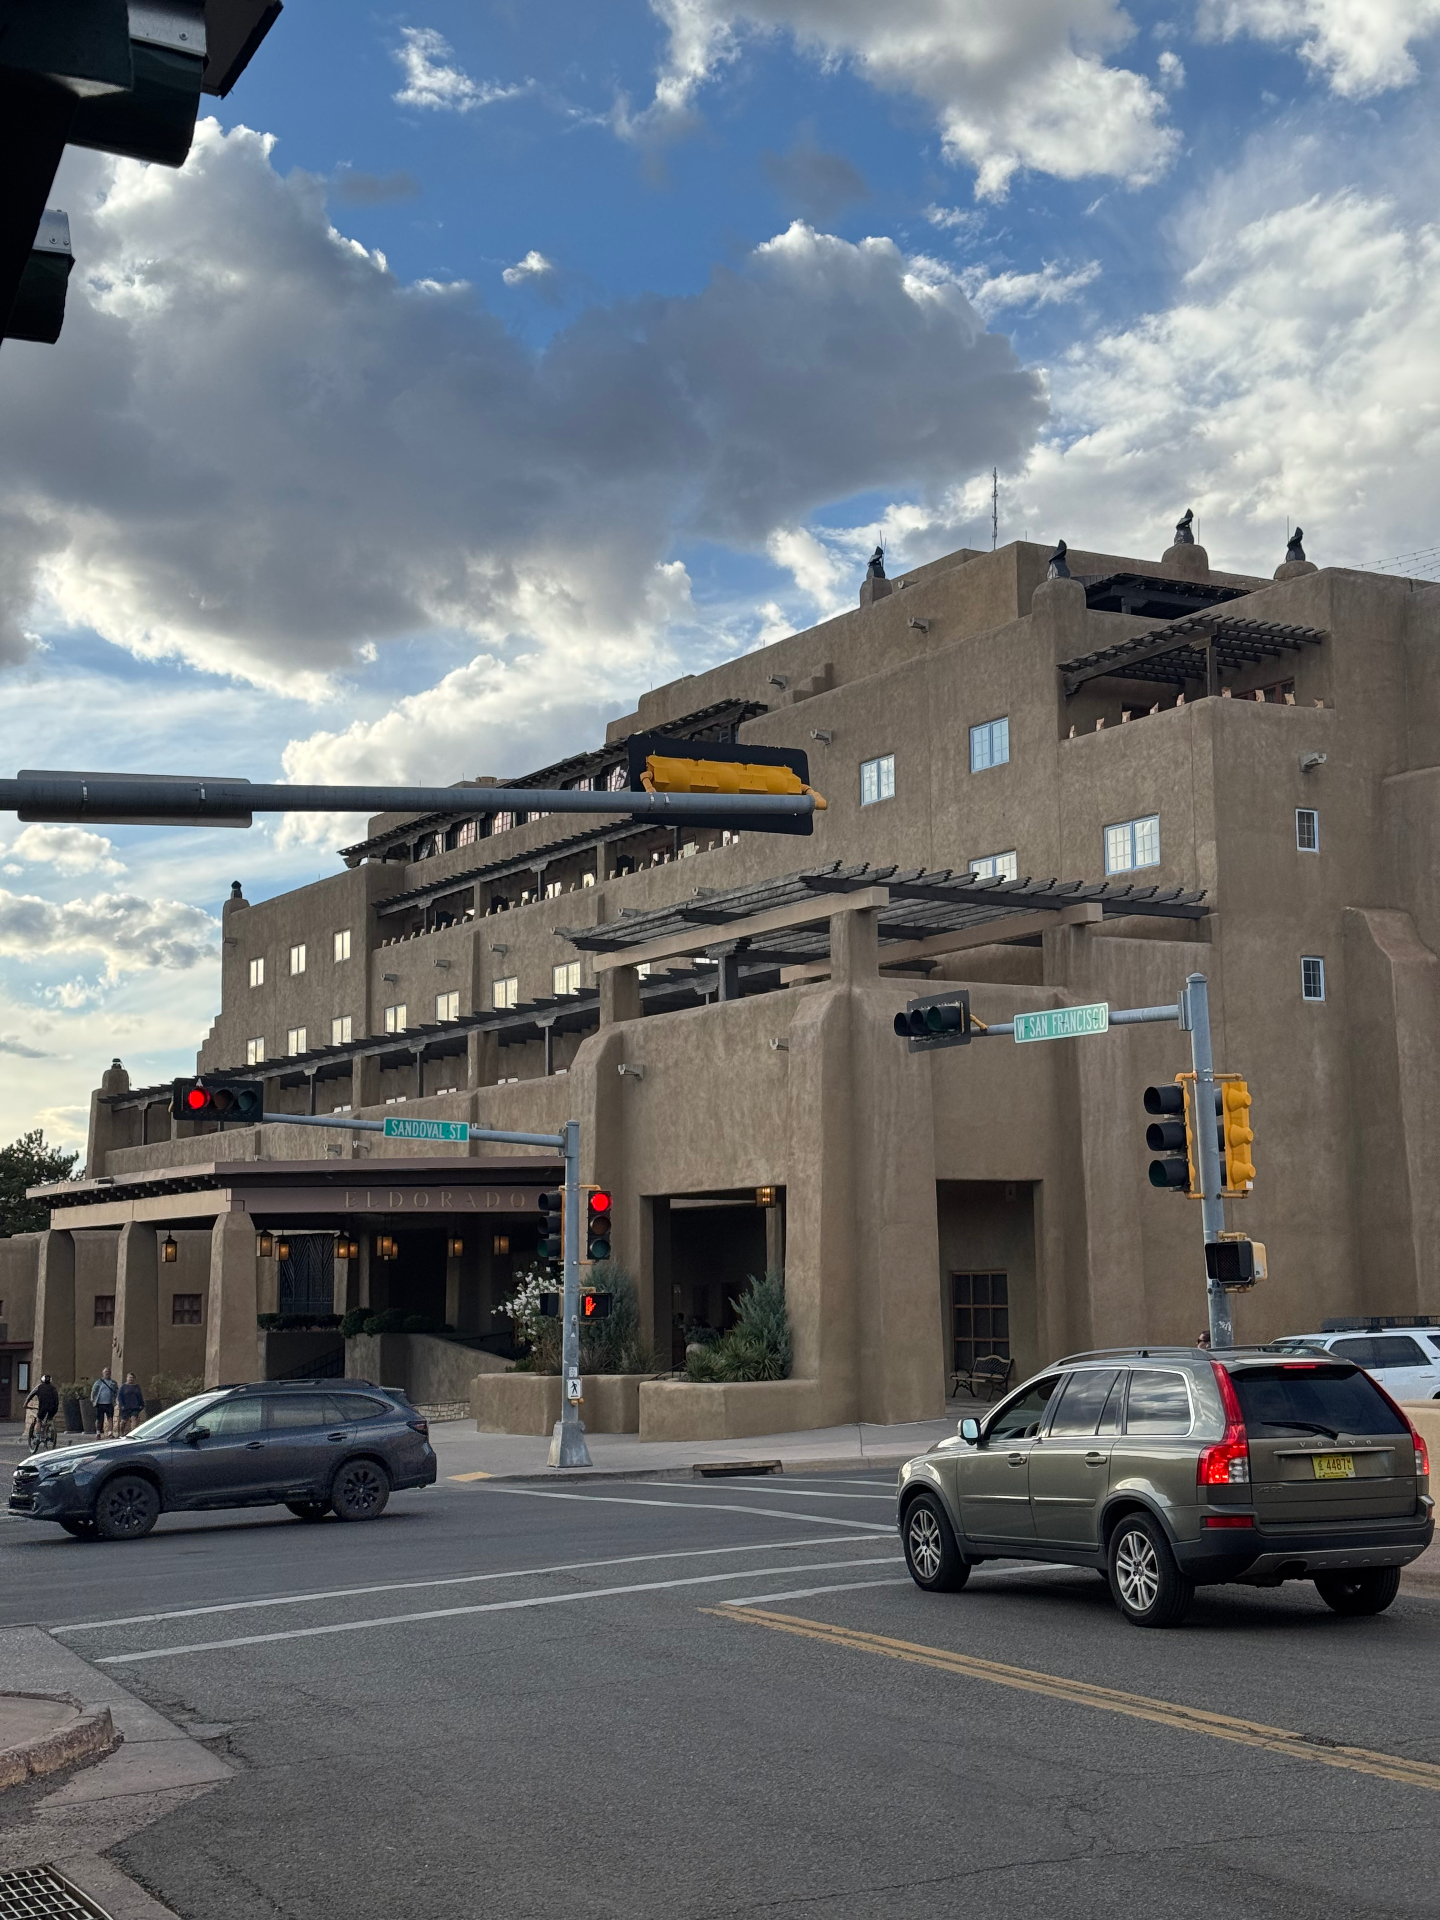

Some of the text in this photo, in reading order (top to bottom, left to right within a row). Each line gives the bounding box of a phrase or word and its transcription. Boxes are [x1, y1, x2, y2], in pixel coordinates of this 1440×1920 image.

[1016, 1006, 1106, 1039] W SAN FRANCISCO
[391, 1119, 462, 1140] SANDOVAL ST
[1299, 1439, 1372, 1448] VOLVO
